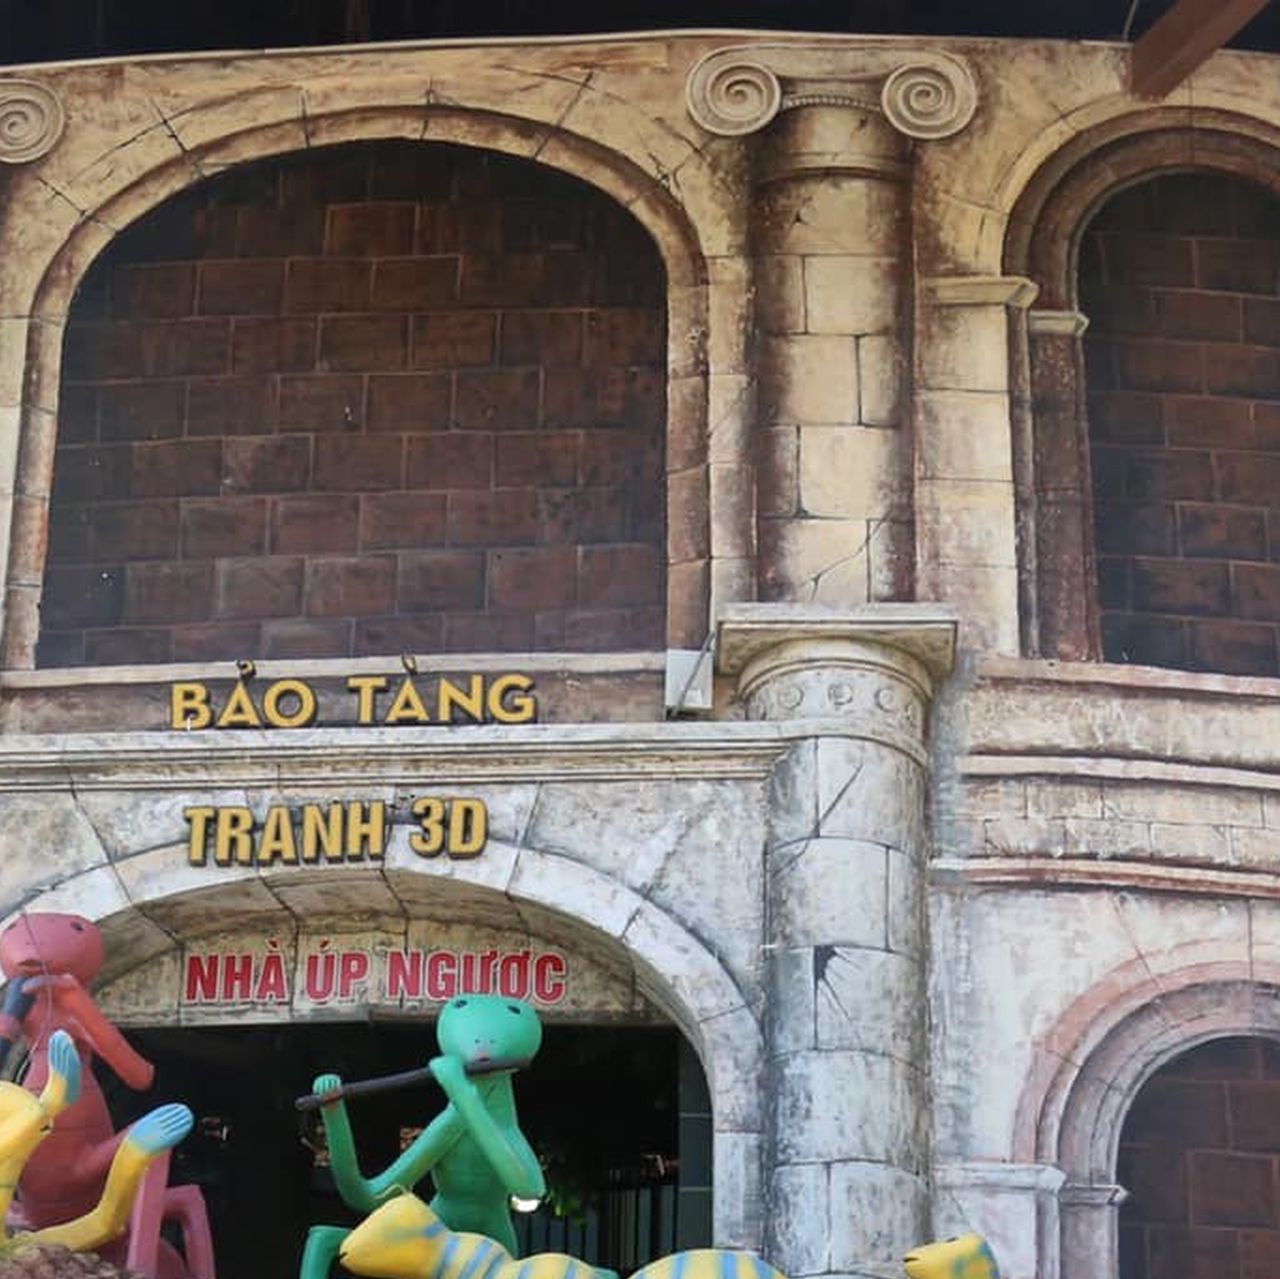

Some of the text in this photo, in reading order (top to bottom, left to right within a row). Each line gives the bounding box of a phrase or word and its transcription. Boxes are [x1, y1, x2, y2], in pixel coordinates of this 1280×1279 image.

[171, 651, 537, 730] BẢO TÀNG
[183, 797, 489, 866] TRANH 3D
[185, 940, 287, 1002] NHÀ
[305, 941, 370, 1002] ÚP
